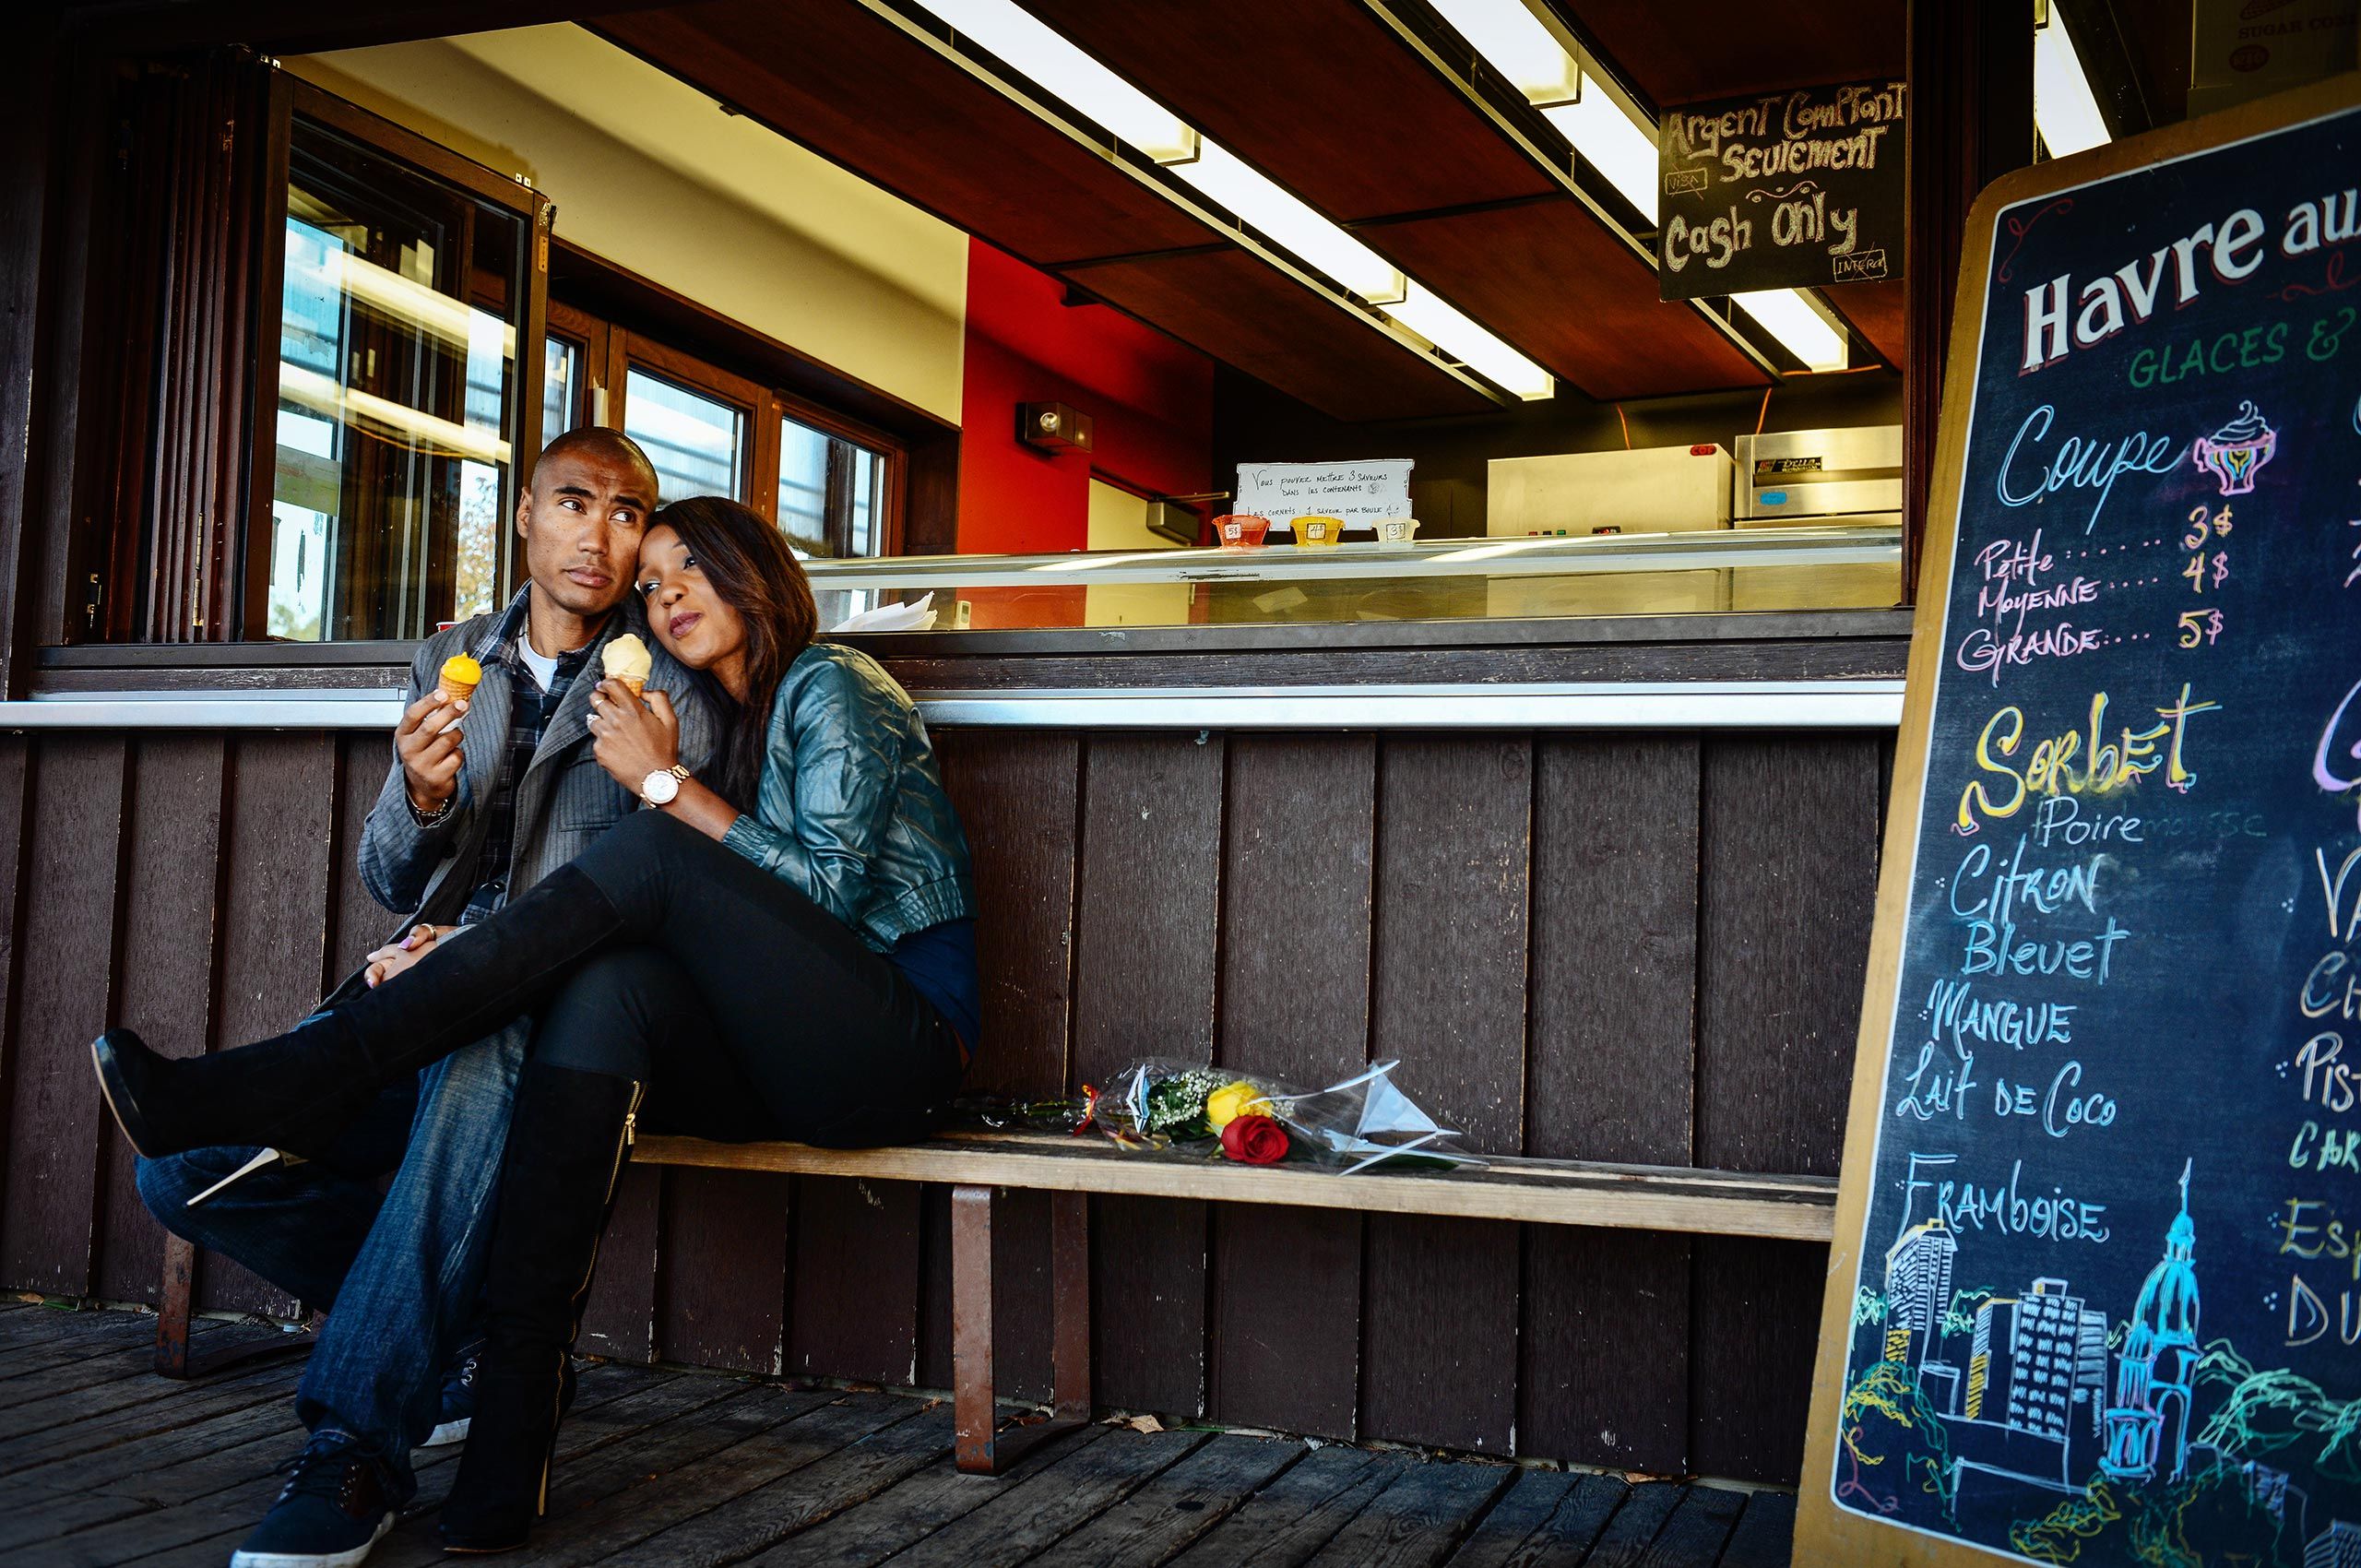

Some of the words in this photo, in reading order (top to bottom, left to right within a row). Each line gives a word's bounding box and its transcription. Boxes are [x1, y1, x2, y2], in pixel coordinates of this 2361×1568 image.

[2020, 208, 2265, 376] Havre
[2280, 188, 2361, 258] au
[2129, 322, 2287, 387] GLACES
[2307, 306, 2356, 362] &
[1349, 470, 1356, 481] 3
[1998, 405, 2189, 535] Coupe
[1306, 506, 1312, 515] 1
[1228, 526, 1238, 536] 5$
[1391, 525, 1403, 536] 3$
[2040, 796, 2144, 848] Poire
